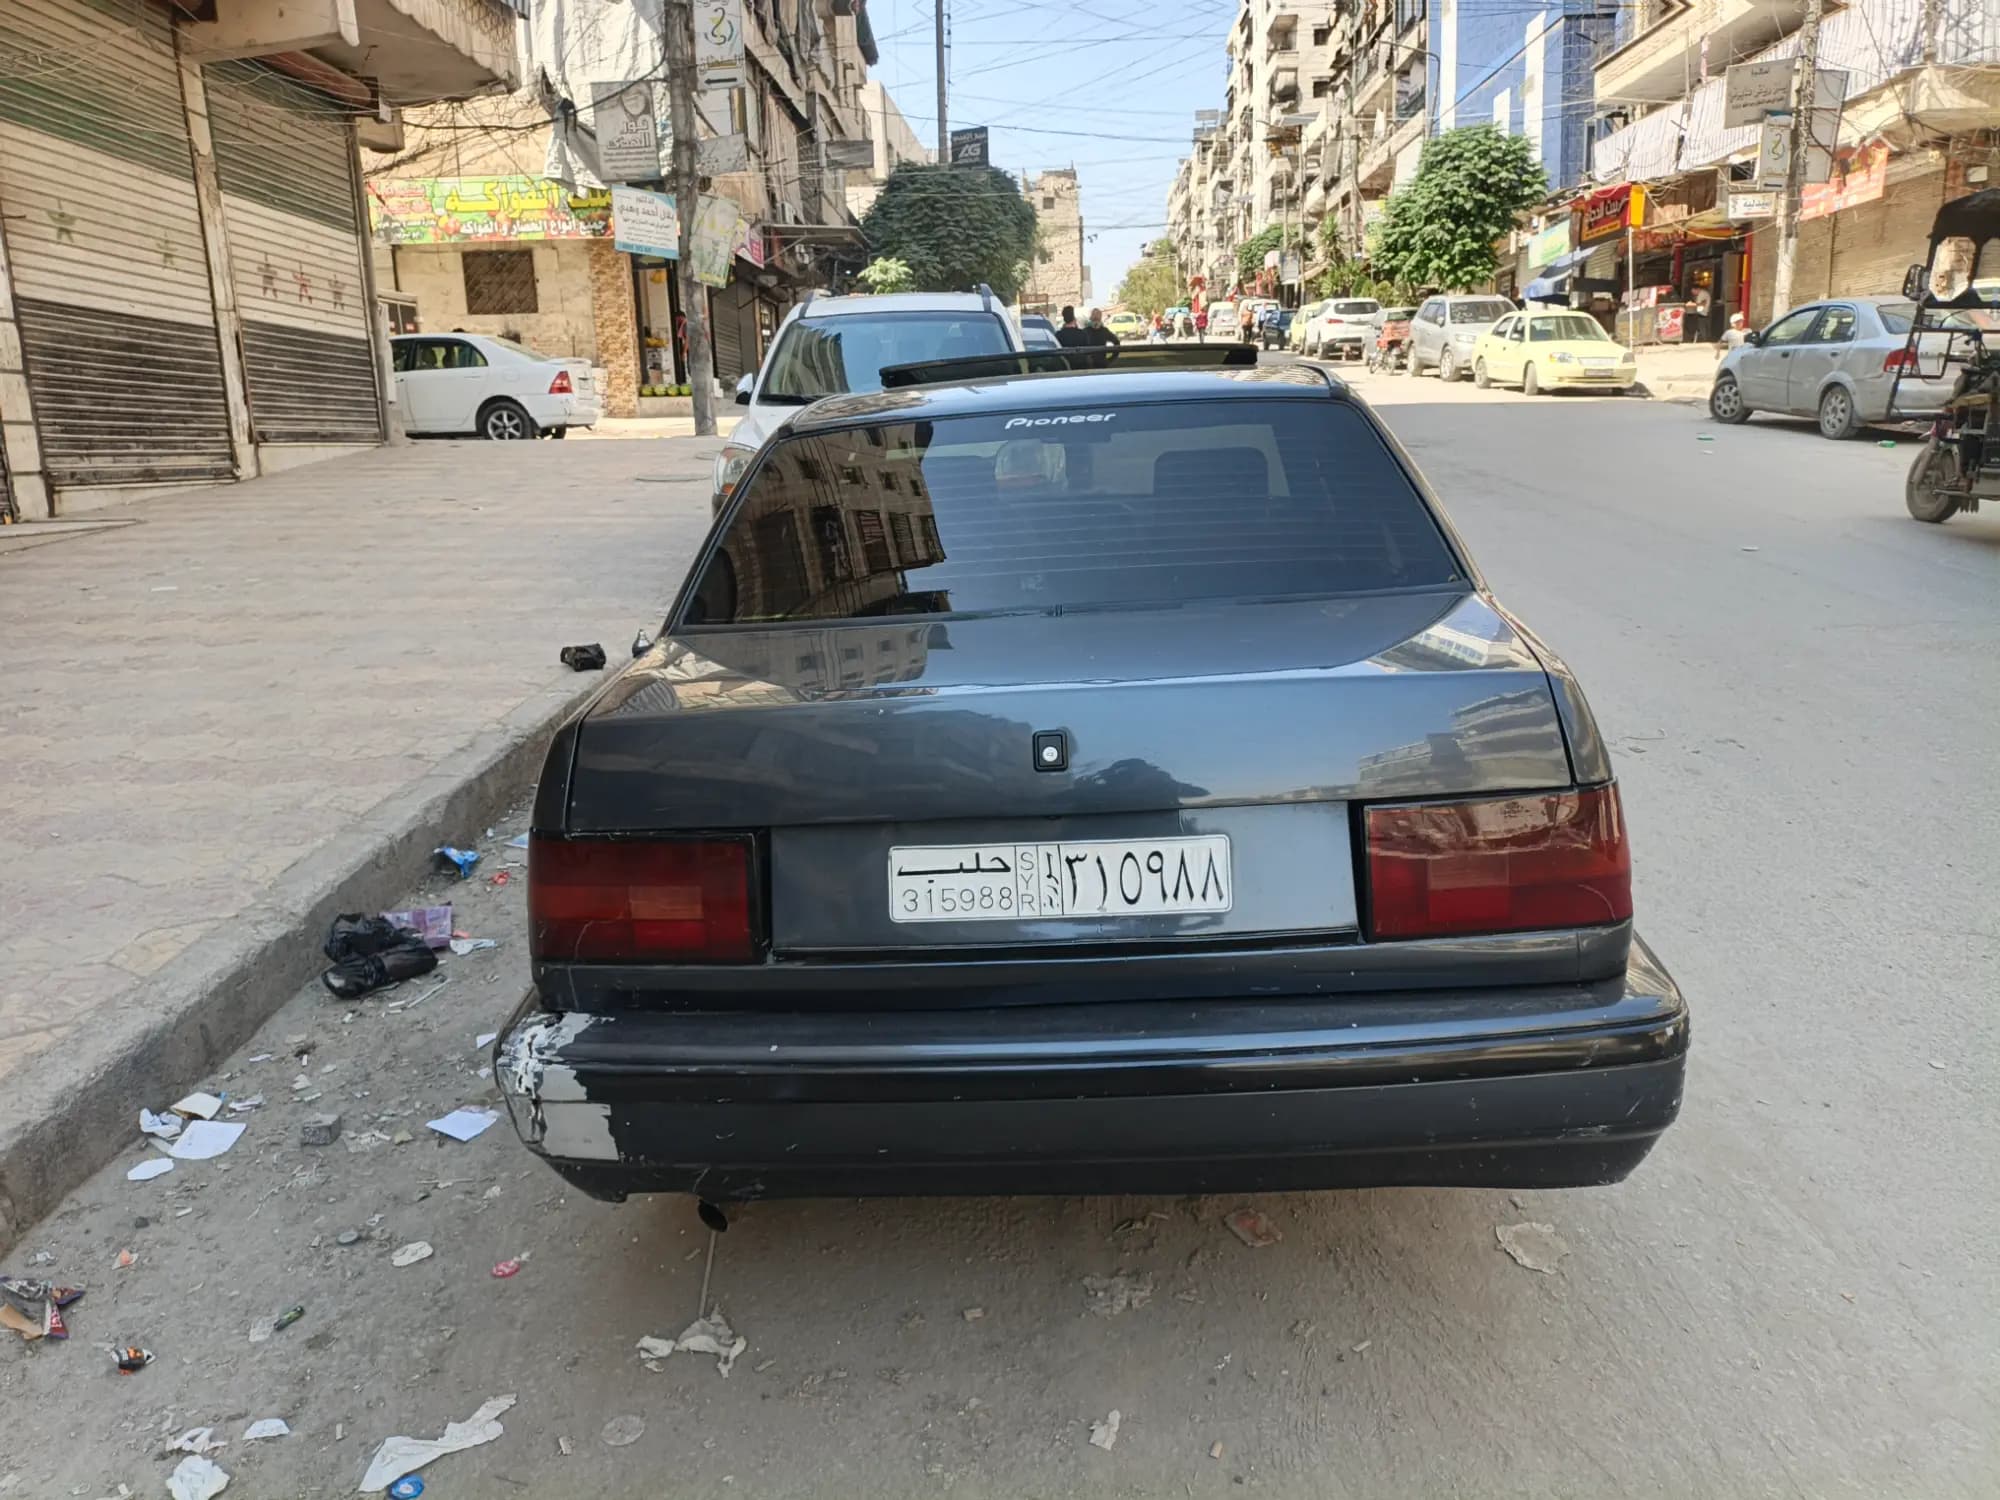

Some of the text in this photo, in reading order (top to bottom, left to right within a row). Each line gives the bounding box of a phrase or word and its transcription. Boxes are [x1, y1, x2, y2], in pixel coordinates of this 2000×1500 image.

[1004, 413, 1117, 430] Pioneer
[897, 852, 1012, 884] حلب
[1065, 848, 1225, 909] ٣١٥٩٨٨
[902, 887, 1013, 914] 315988
